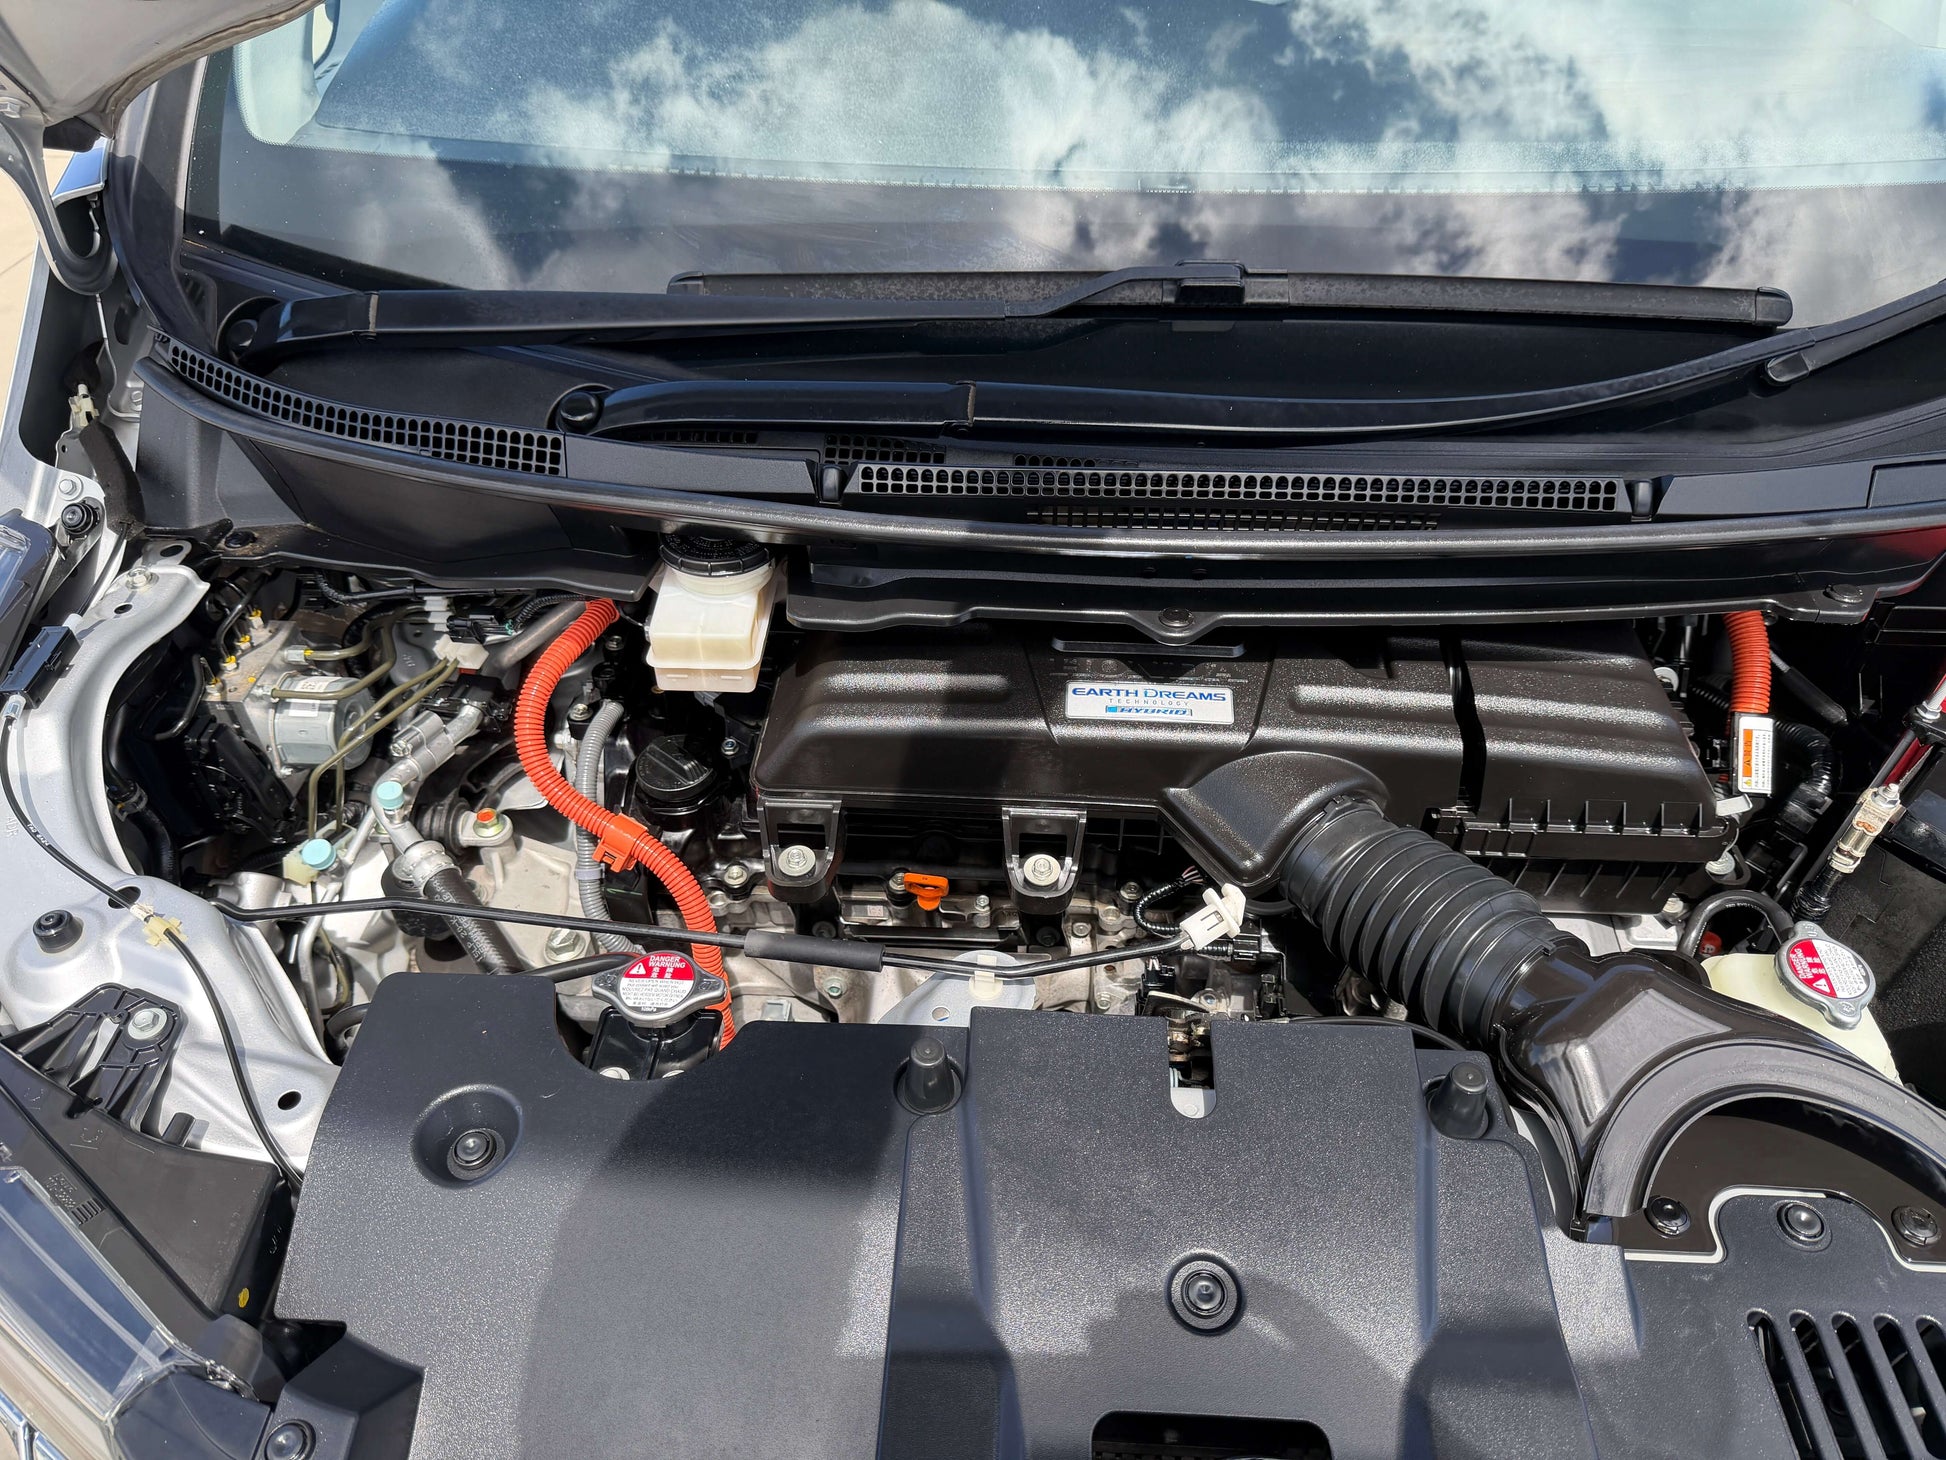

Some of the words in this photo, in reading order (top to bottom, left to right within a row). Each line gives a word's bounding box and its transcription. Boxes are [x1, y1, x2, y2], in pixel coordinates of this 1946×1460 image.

[1072, 687, 1139, 698] EARTH
[1143, 688, 1227, 702] DREAMS
[1119, 707, 1188, 716] HYBRID
[648, 960, 686, 968] WARNUNG
[1790, 953, 1807, 979] DANGER
